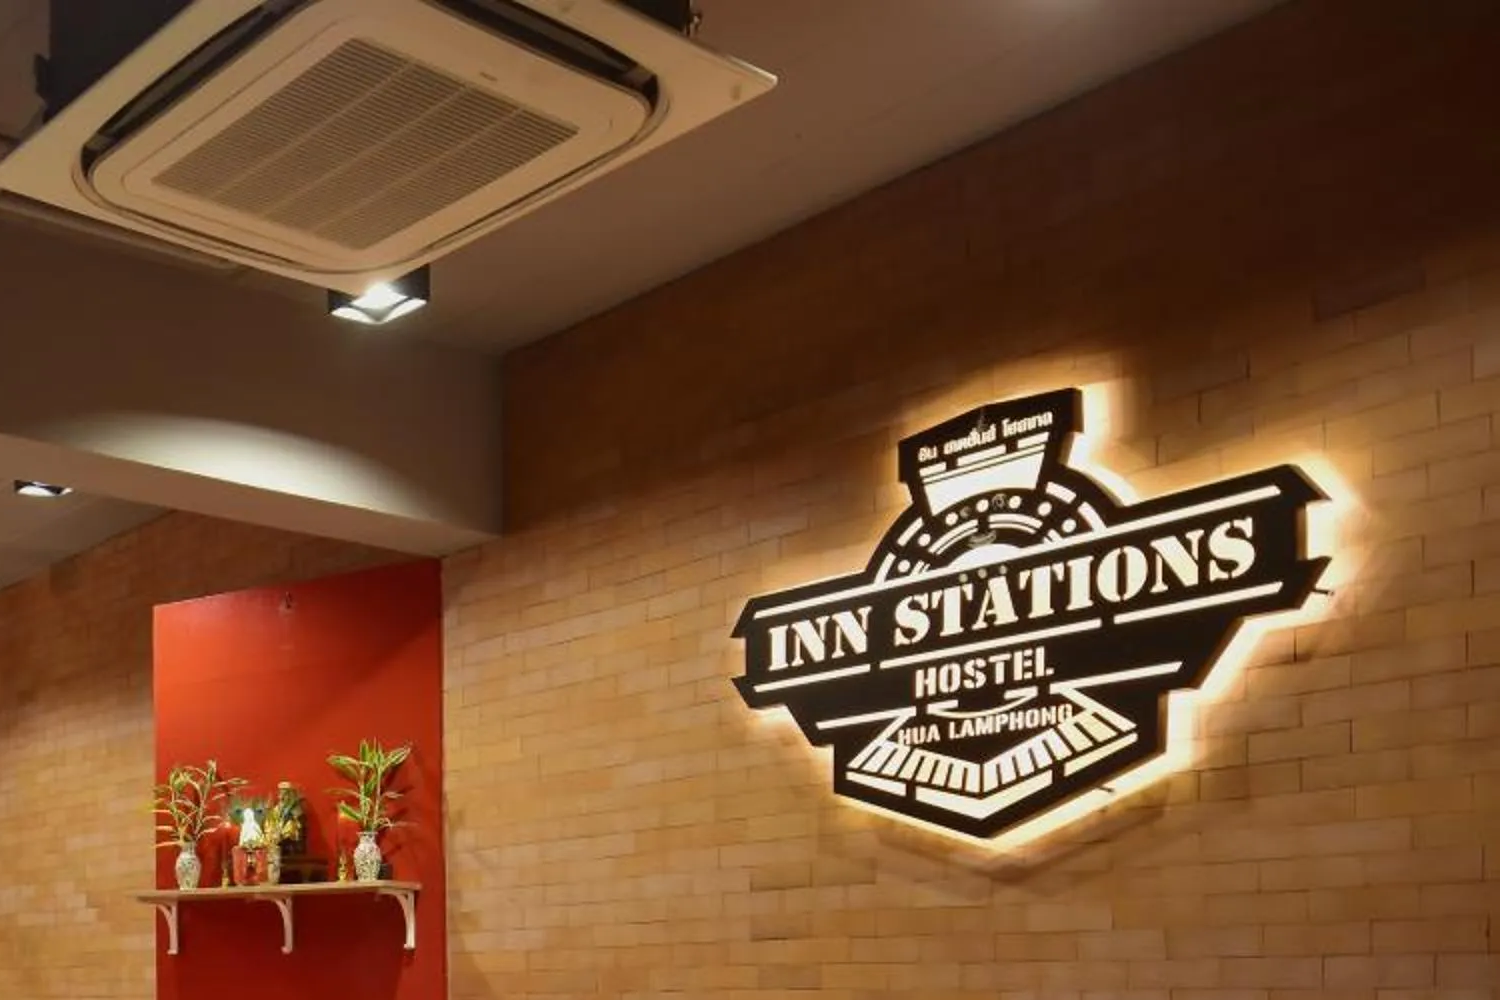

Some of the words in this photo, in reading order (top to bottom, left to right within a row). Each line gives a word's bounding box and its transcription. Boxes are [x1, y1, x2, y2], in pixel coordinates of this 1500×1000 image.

[768, 606, 872, 671] INN
[894, 517, 1255, 646] STATIONS
[915, 647, 1054, 698] HOSTEL
[898, 724, 941, 746] HUA
